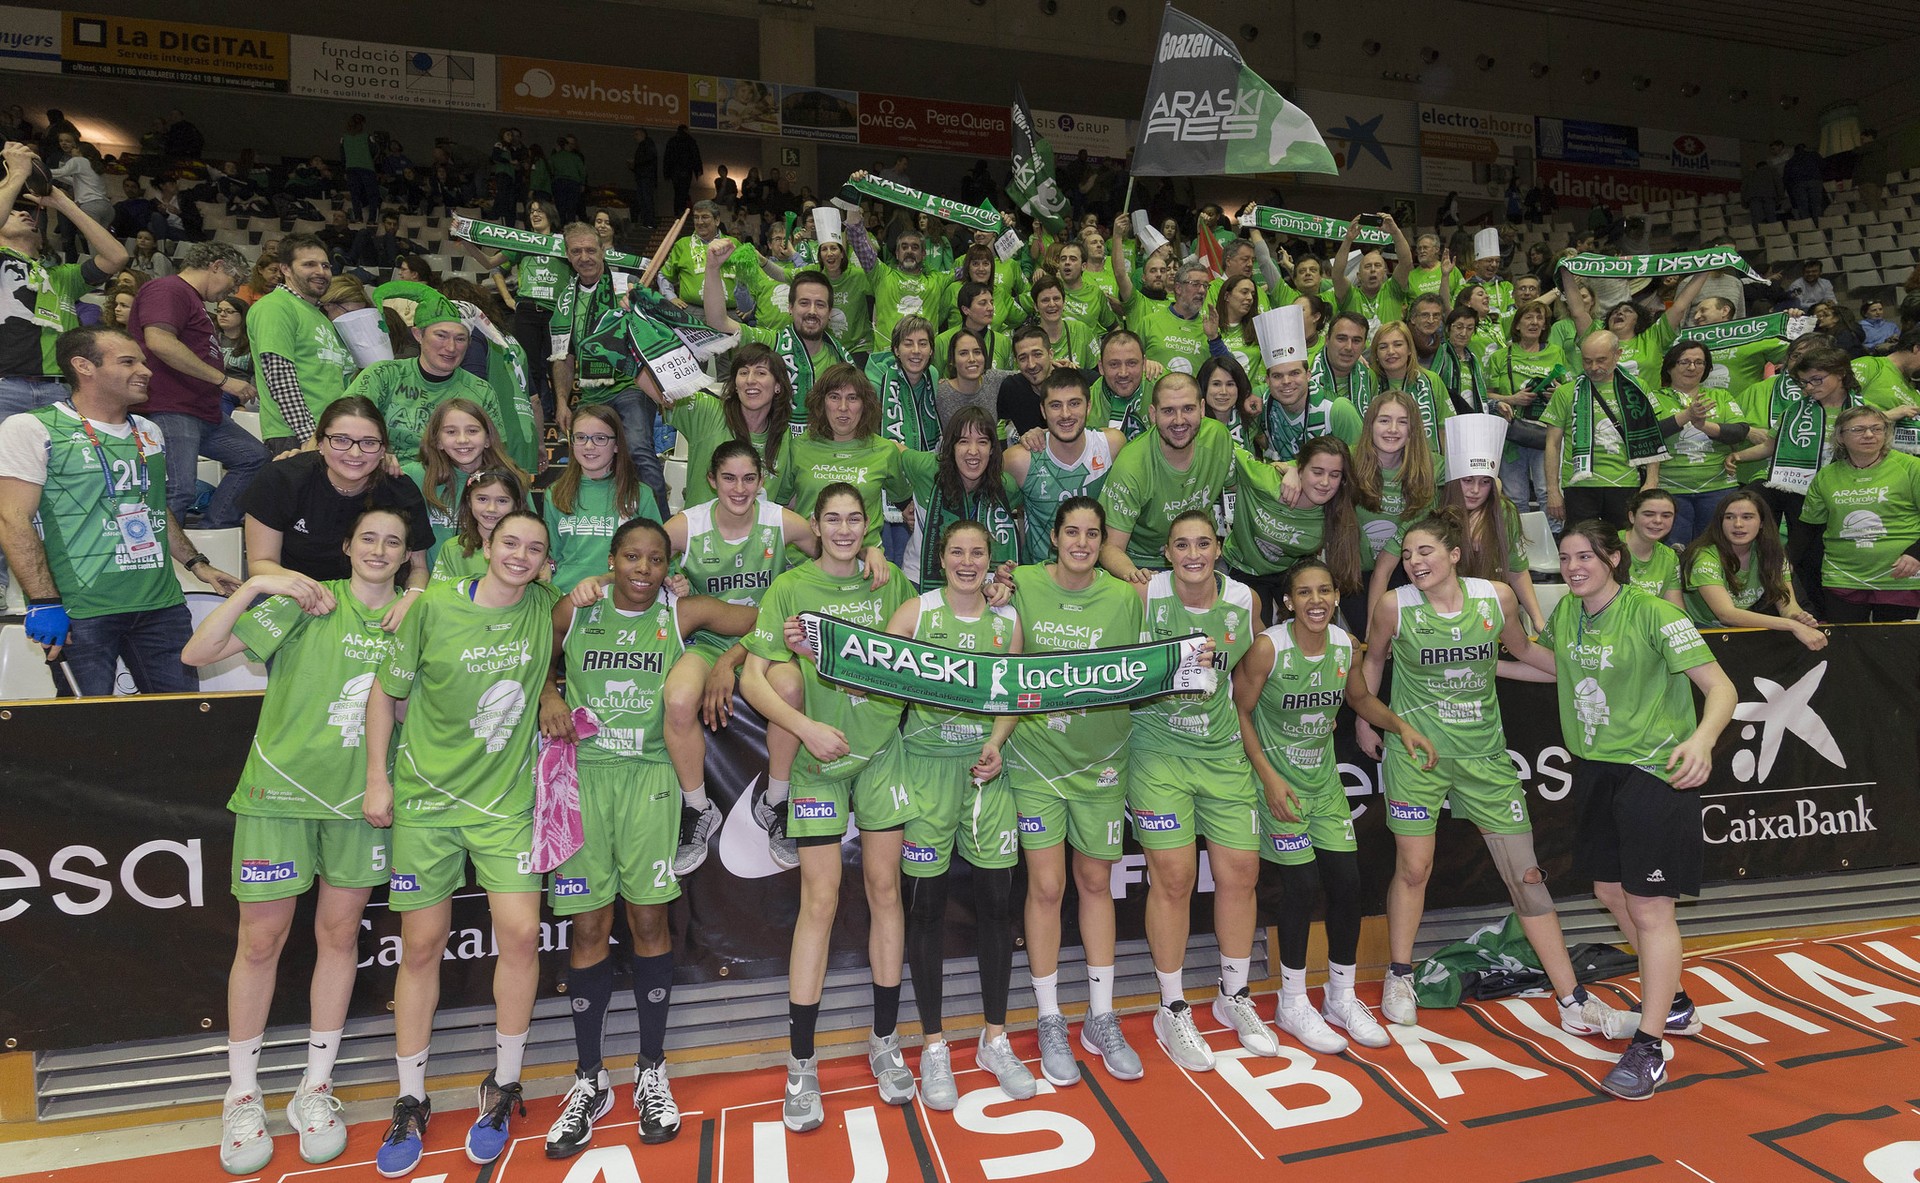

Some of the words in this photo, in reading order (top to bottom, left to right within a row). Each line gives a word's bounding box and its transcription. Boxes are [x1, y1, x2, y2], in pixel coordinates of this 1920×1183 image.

[116, 26, 148, 48] La
[159, 31, 275, 60] DIGITAL
[117, 49, 158, 61] Serveis
[161, 53, 209, 66] integrals
[321, 42, 400, 63] fundació
[336, 58, 400, 76] Ramon
[314, 69, 400, 89] Noguera
[333, 89, 370, 101] qualitat
[389, 93, 409, 102] vida
[413, 94, 425, 103] de
[561, 79, 680, 115] swhosting
[1150, 88, 1265, 120] ARASKI
[567, 109, 635, 121] www.swhosting.com
[859, 112, 918, 130] OMEGA
[926, 109, 959, 126] Pere
[961, 112, 1006, 132] Quera
[1422, 108, 1533, 135] electroahorro
[782, 127, 857, 142] cateringvilanova.com
[1076, 122, 1110, 134] GRUP
[941, 199, 1000, 221] lacturale
[1270, 214, 1322, 236] lacturale
[479, 225, 548, 246] ARASKI
[1658, 252, 1742, 272] ARASKI
[1164, 336, 1195, 345] ARASKI
[1688, 320, 1768, 343] lacturale
[1166, 342, 1195, 353] lacturale
[655, 354, 687, 374] araba
[673, 363, 699, 380] álava
[811, 464, 857, 472] ARASKI
[814, 471, 857, 482] lacturale
[1773, 469, 1801, 478] araba
[1832, 487, 1878, 497] ARASKI
[1835, 495, 1877, 506] lacturale
[558, 516, 614, 527] ARASKI
[1255, 507, 1297, 533] ARASKI
[1255, 517, 1290, 543] lacturale
[735, 554, 743, 567] 6
[707, 570, 772, 593] ARASKI
[819, 600, 872, 616] ARASKI
[253, 608, 282, 638] álava
[1032, 621, 1090, 638] ARASKI
[616, 629, 637, 646] 24
[958, 632, 975, 650] 26
[1036, 634, 1087, 650] lacturale
[1451, 627, 1462, 641] 9
[460, 641, 520, 661] ARASKI
[1421, 642, 1494, 665] ARASKI
[467, 655, 520, 674] lacturale
[583, 650, 662, 674] ARASKI
[840, 633, 977, 688] ARASKI
[1018, 657, 1147, 690] lacturale
[1181, 655, 1194, 688] araba
[1310, 671, 1322, 687] 21
[638, 688, 655, 696] leche
[1428, 678, 1488, 692] lacturale
[587, 694, 654, 711] lacturale
[890, 786, 909, 810] 14
[796, 804, 833, 818] Diario
[1390, 805, 1425, 820] Diario
[1510, 800, 1523, 822] 9
[1701, 794, 1878, 844] CaixaBank
[1138, 815, 1174, 831] Diario
[1107, 822, 1121, 845] 13
[1000, 831, 1018, 855] 26
[1275, 836, 1310, 852] Diario
[371, 845, 387, 871] 5
[516, 852, 531, 874] 8
[902, 846, 933, 862] Diario
[0, 838, 204, 922] esa
[241, 866, 290, 881] Diario
